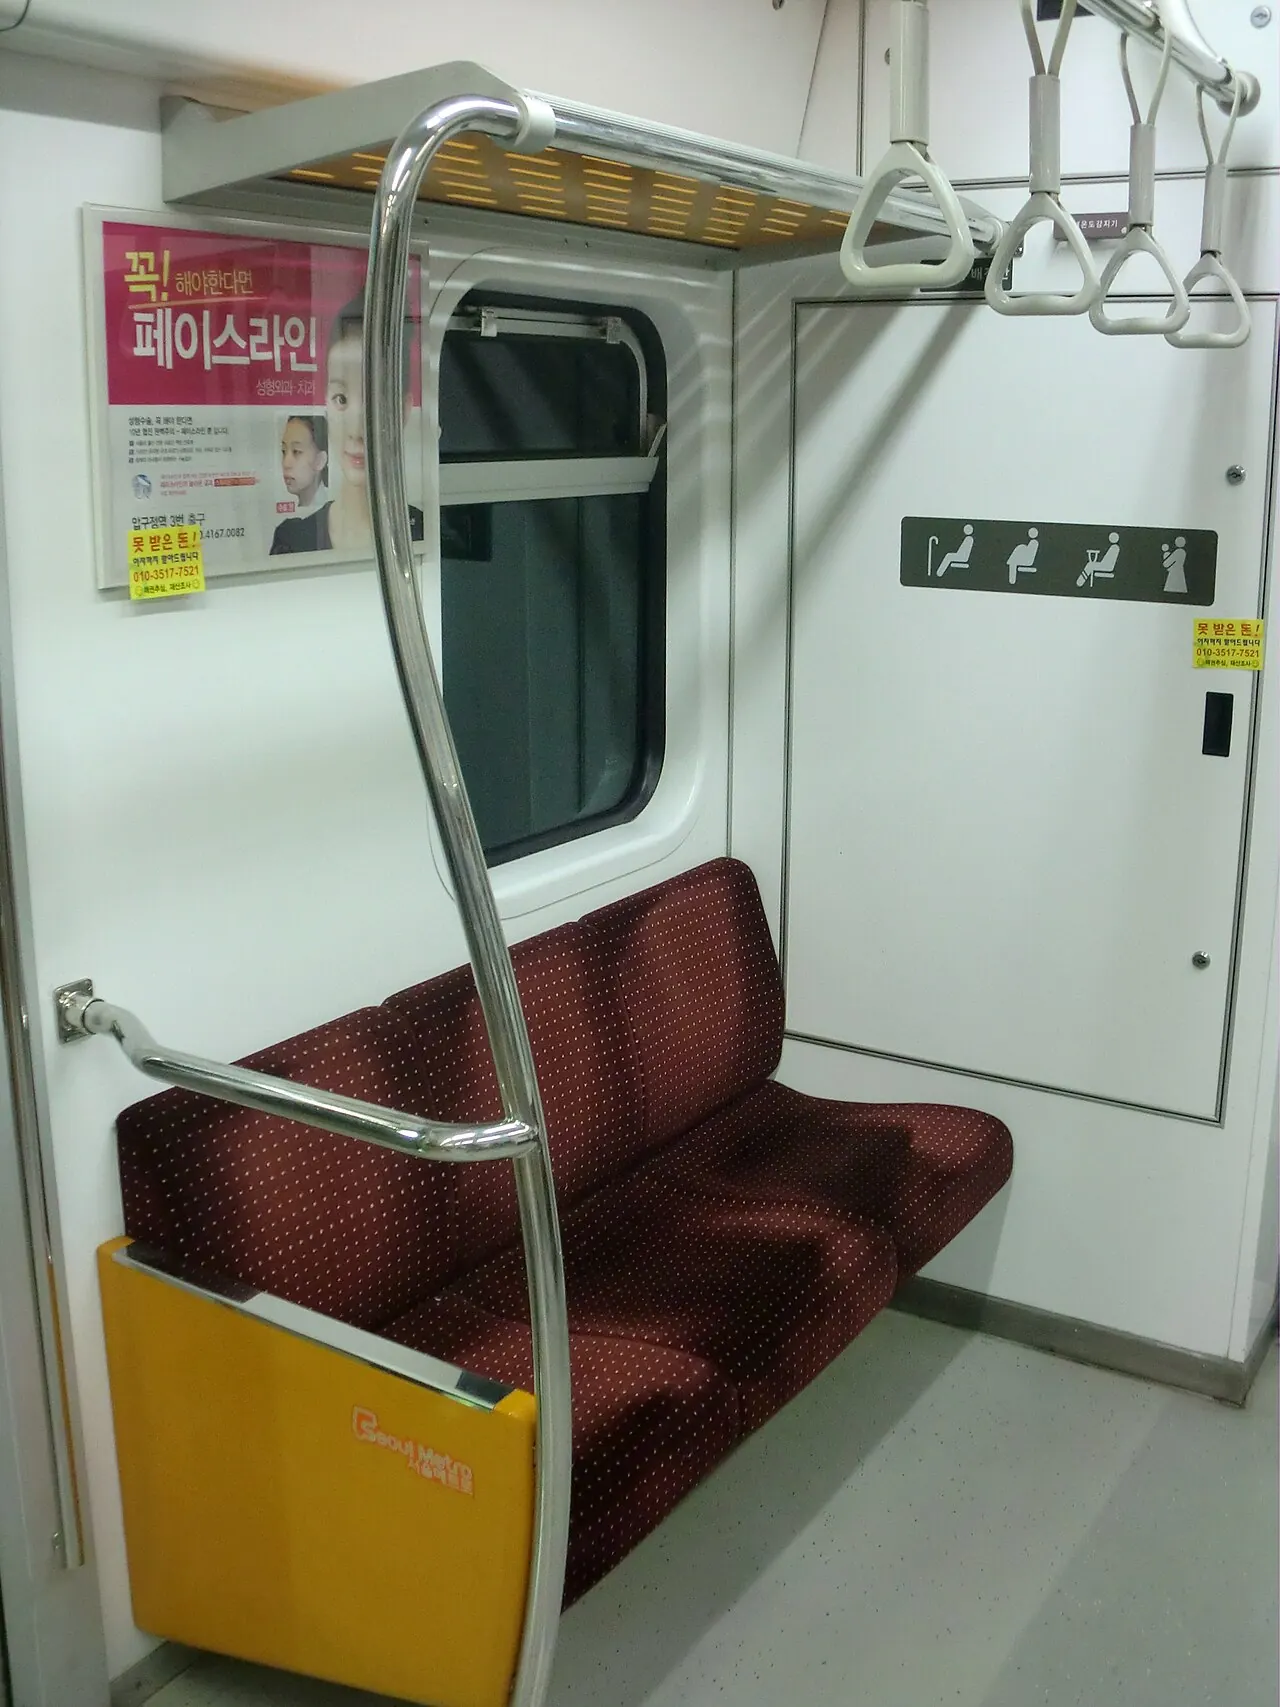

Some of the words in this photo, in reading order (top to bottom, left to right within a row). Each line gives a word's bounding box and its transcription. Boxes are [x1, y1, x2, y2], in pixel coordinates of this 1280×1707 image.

[1077, 219, 1118, 229] 온도감지기
[124, 250, 171, 302] 꼭!
[133, 307, 318, 372] 페이스라인
[131, 514, 167, 531] 압구정역
[170, 513, 184, 528] 3번
[133, 536, 144, 553] 못
[149, 534, 172, 552] 받은
[133, 565, 199, 583] 010-3517-7521
[1198, 623, 1208, 635] 못
[1213, 623, 1236, 636] 받은
[1196, 648, 1260, 658] 010-3517-7521
